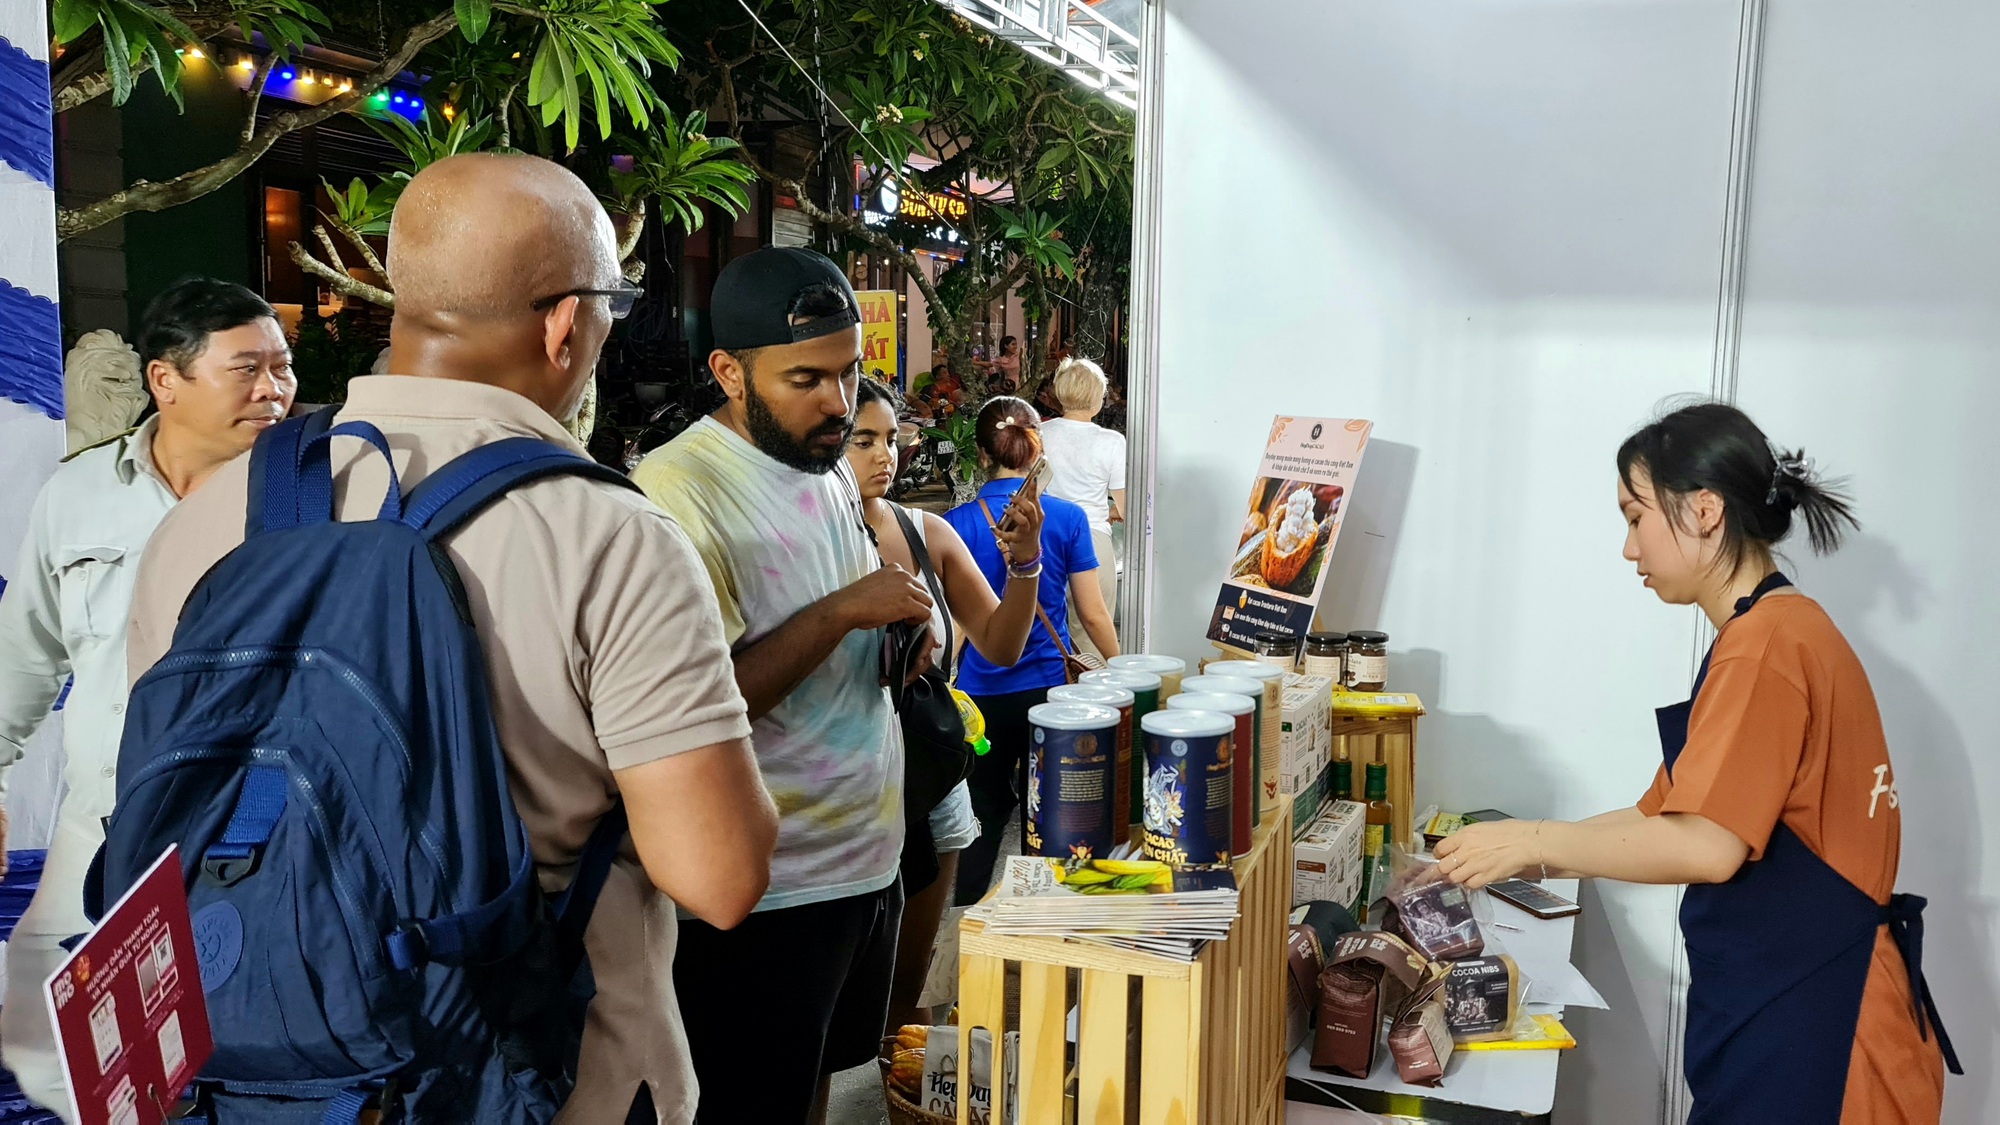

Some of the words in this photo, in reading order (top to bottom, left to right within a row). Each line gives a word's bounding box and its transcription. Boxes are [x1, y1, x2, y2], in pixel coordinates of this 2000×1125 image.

[859, 296, 891, 324] HÀ
[862, 332, 889, 361] ẤT
[1452, 967, 1480, 977] COCOA
[1482, 965, 1500, 974] NIBS
